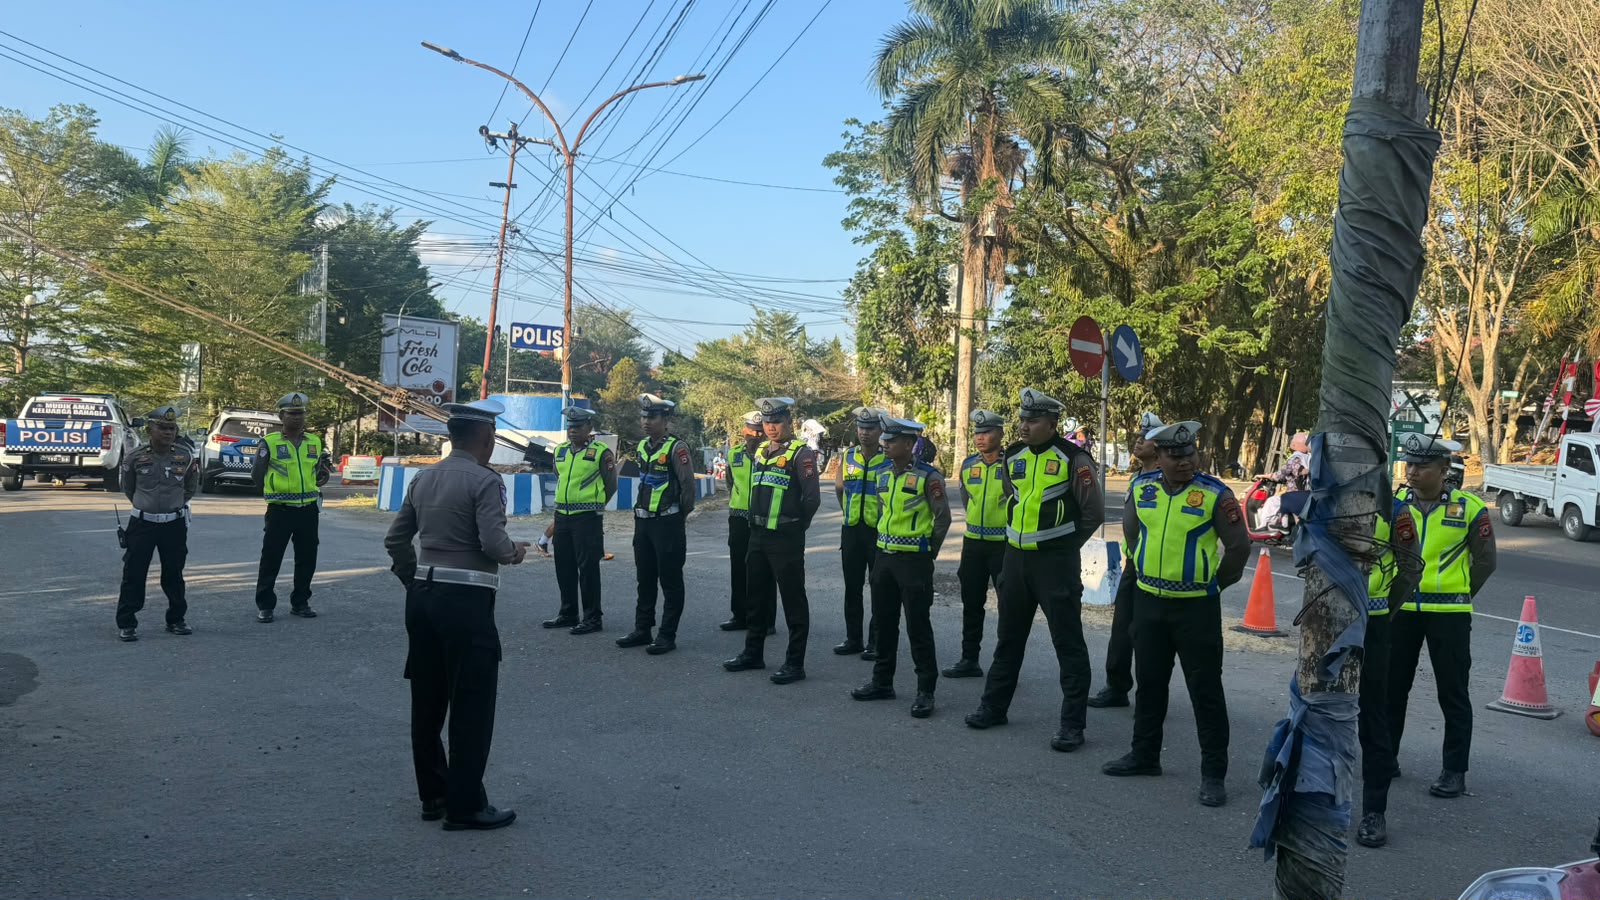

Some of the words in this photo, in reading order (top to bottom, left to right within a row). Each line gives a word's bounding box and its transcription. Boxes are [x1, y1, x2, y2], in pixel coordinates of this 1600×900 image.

[512, 326, 563, 347] POLIS
[400, 340, 438, 358] Fresh
[402, 357, 432, 377] Cola
[20, 431, 87, 443] POLISI
[246, 426, 268, 435] 701
